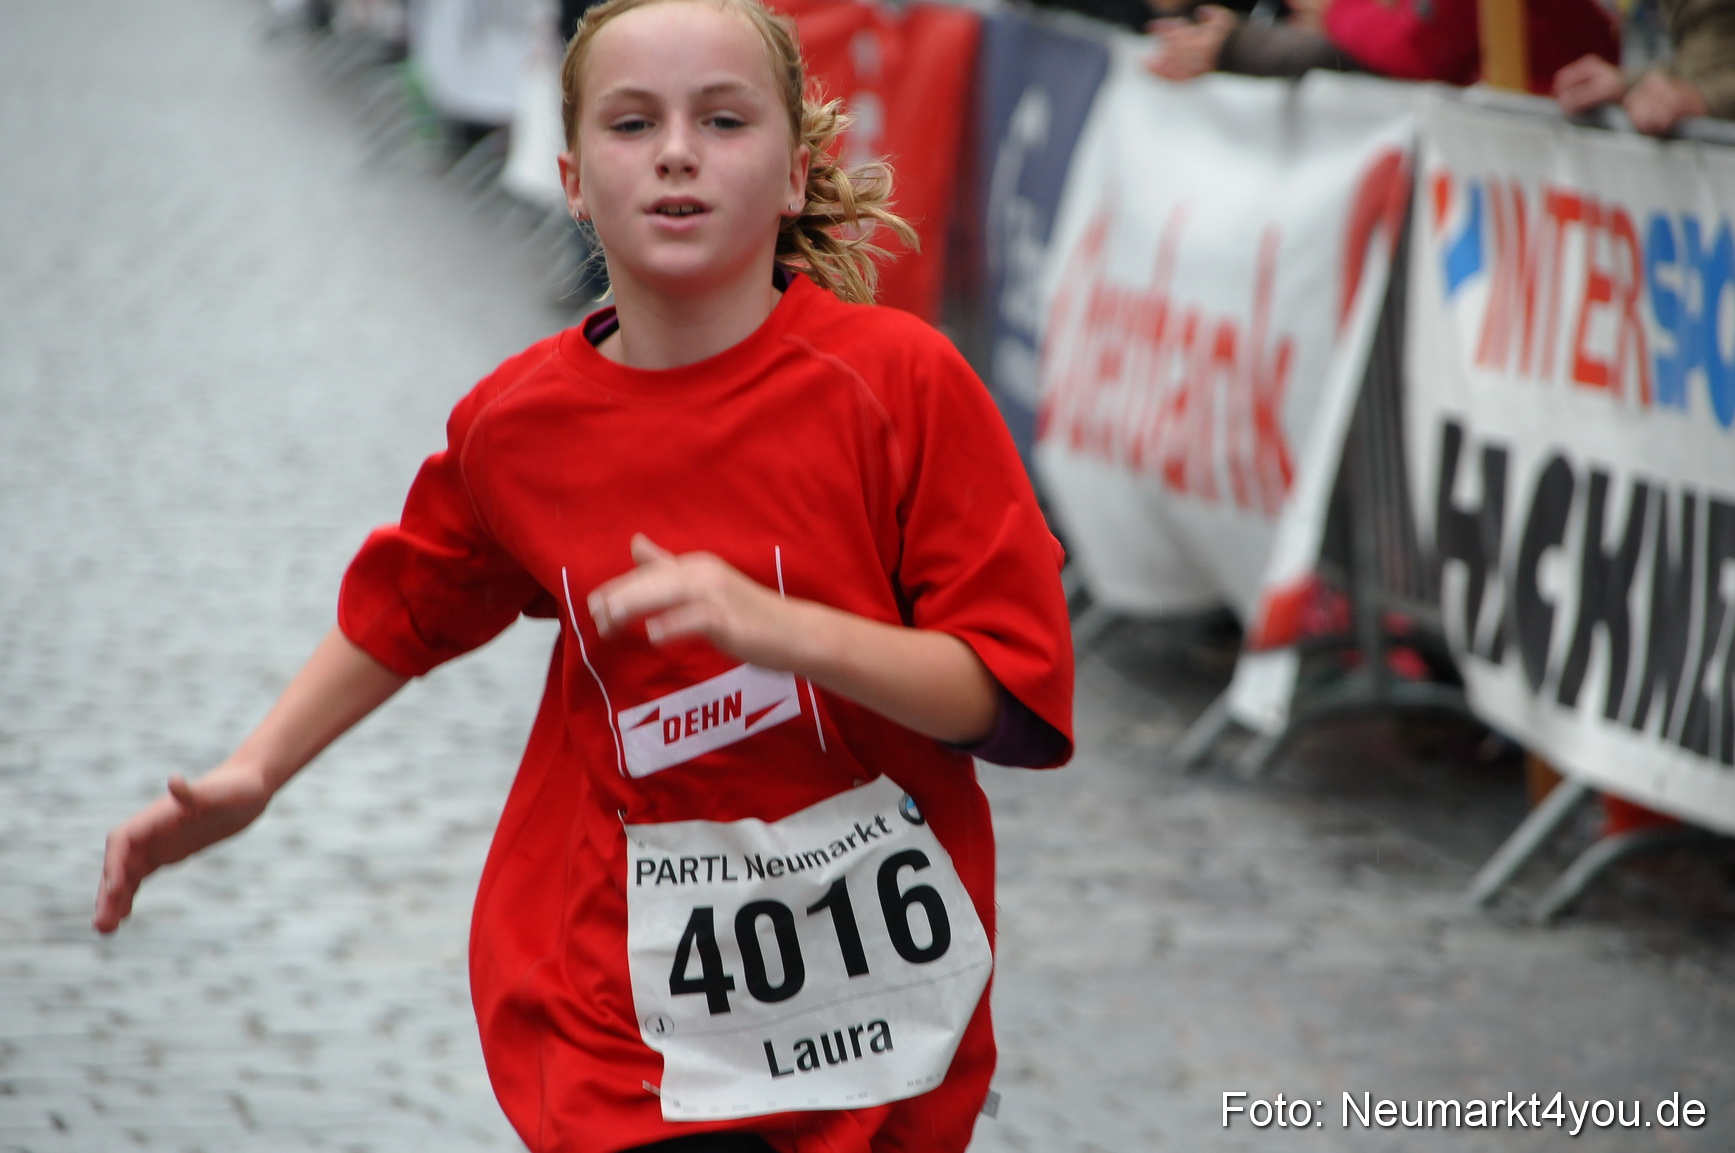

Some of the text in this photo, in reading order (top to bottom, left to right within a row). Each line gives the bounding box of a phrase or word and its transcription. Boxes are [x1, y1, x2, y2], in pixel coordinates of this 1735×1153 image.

[664, 689, 742, 746] DEHN
[636, 814, 893, 887] PARTL Neumarkt
[669, 848, 951, 1016] 4016
[763, 1018, 893, 1078] Laura
